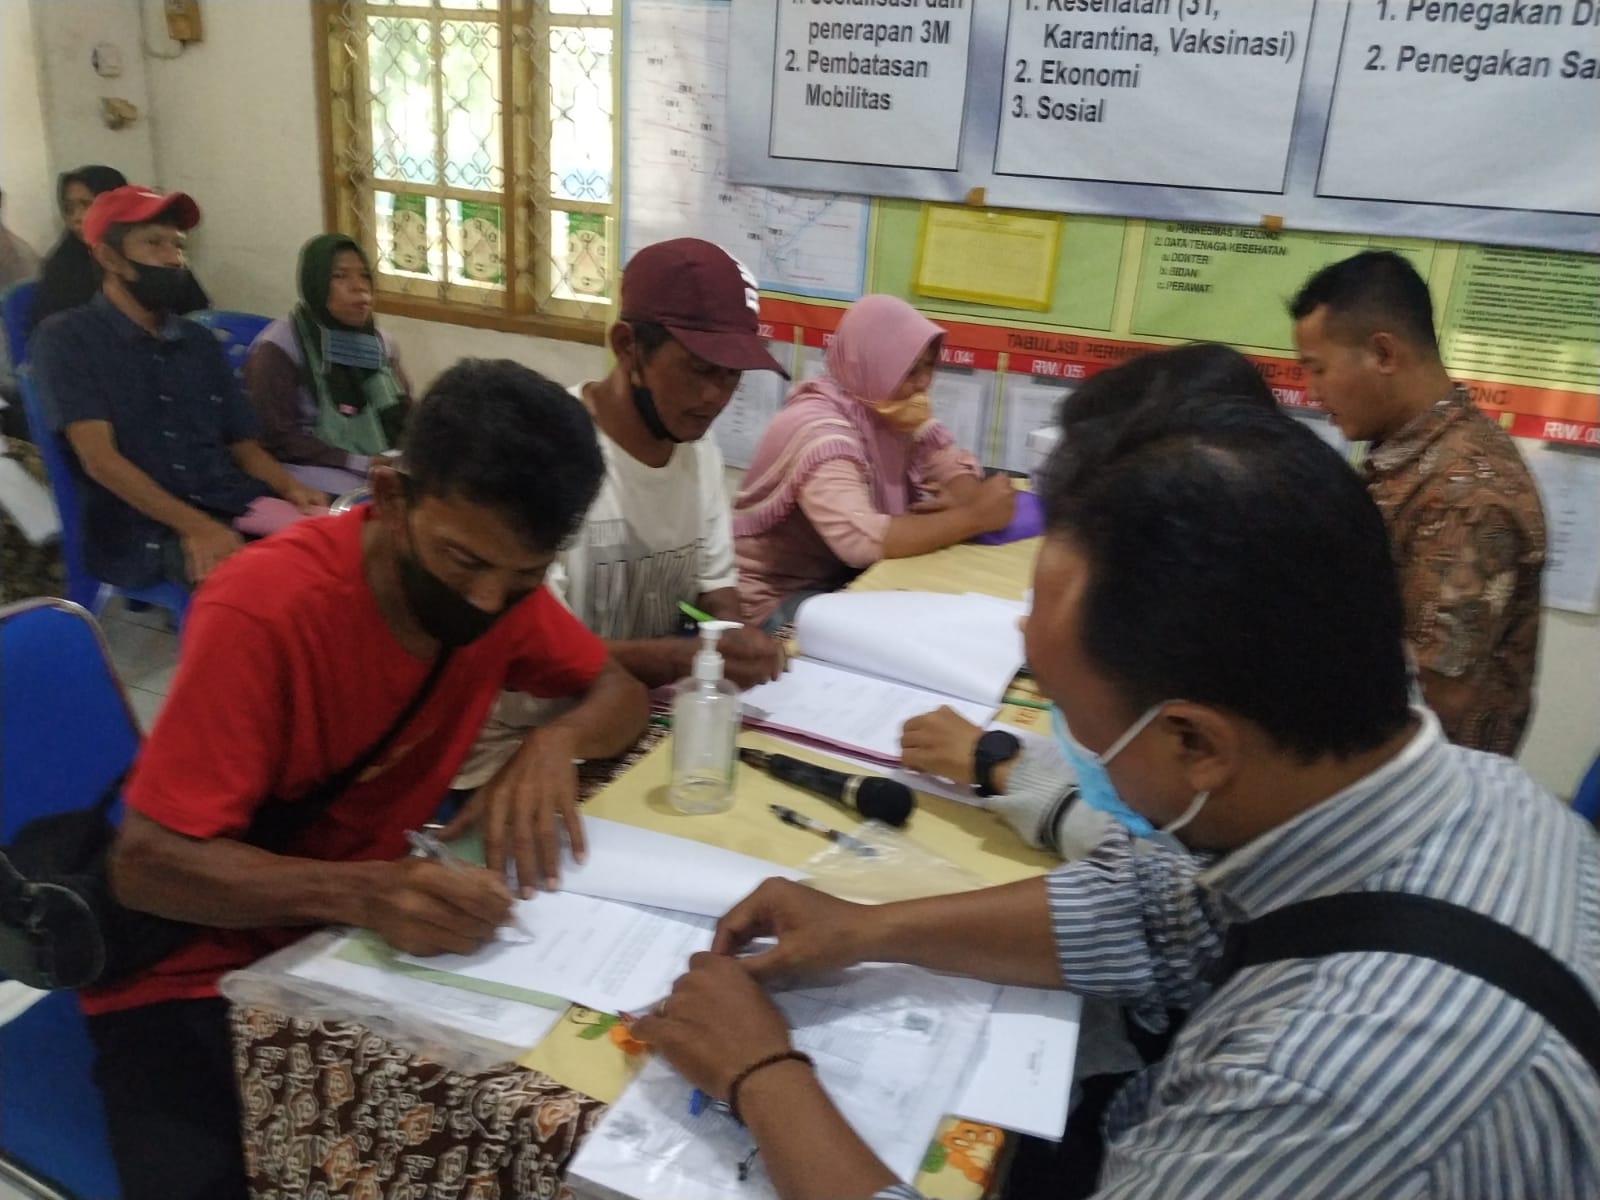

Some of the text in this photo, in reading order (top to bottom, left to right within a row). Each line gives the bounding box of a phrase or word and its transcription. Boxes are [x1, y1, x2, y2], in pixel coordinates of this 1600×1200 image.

[1376, 0, 1395, 20] 1.
[1406, 0, 1562, 30] Penegakan
[808, 20, 950, 46] penerapan 3M
[1043, 23, 1296, 64] Karantina, Vaksinasi)
[785, 49, 929, 79] 2. Pembatasan
[1014, 59, 1141, 89] 2. Ekonomi
[1364, 45, 1600, 81] 2. Penegakan Sa
[805, 83, 893, 111] Mobilitas
[1012, 95, 1105, 123] 3. Sosial
[1189, 239, 1228, 252] TENAGA
[1008, 333, 1079, 355] TABULASI
